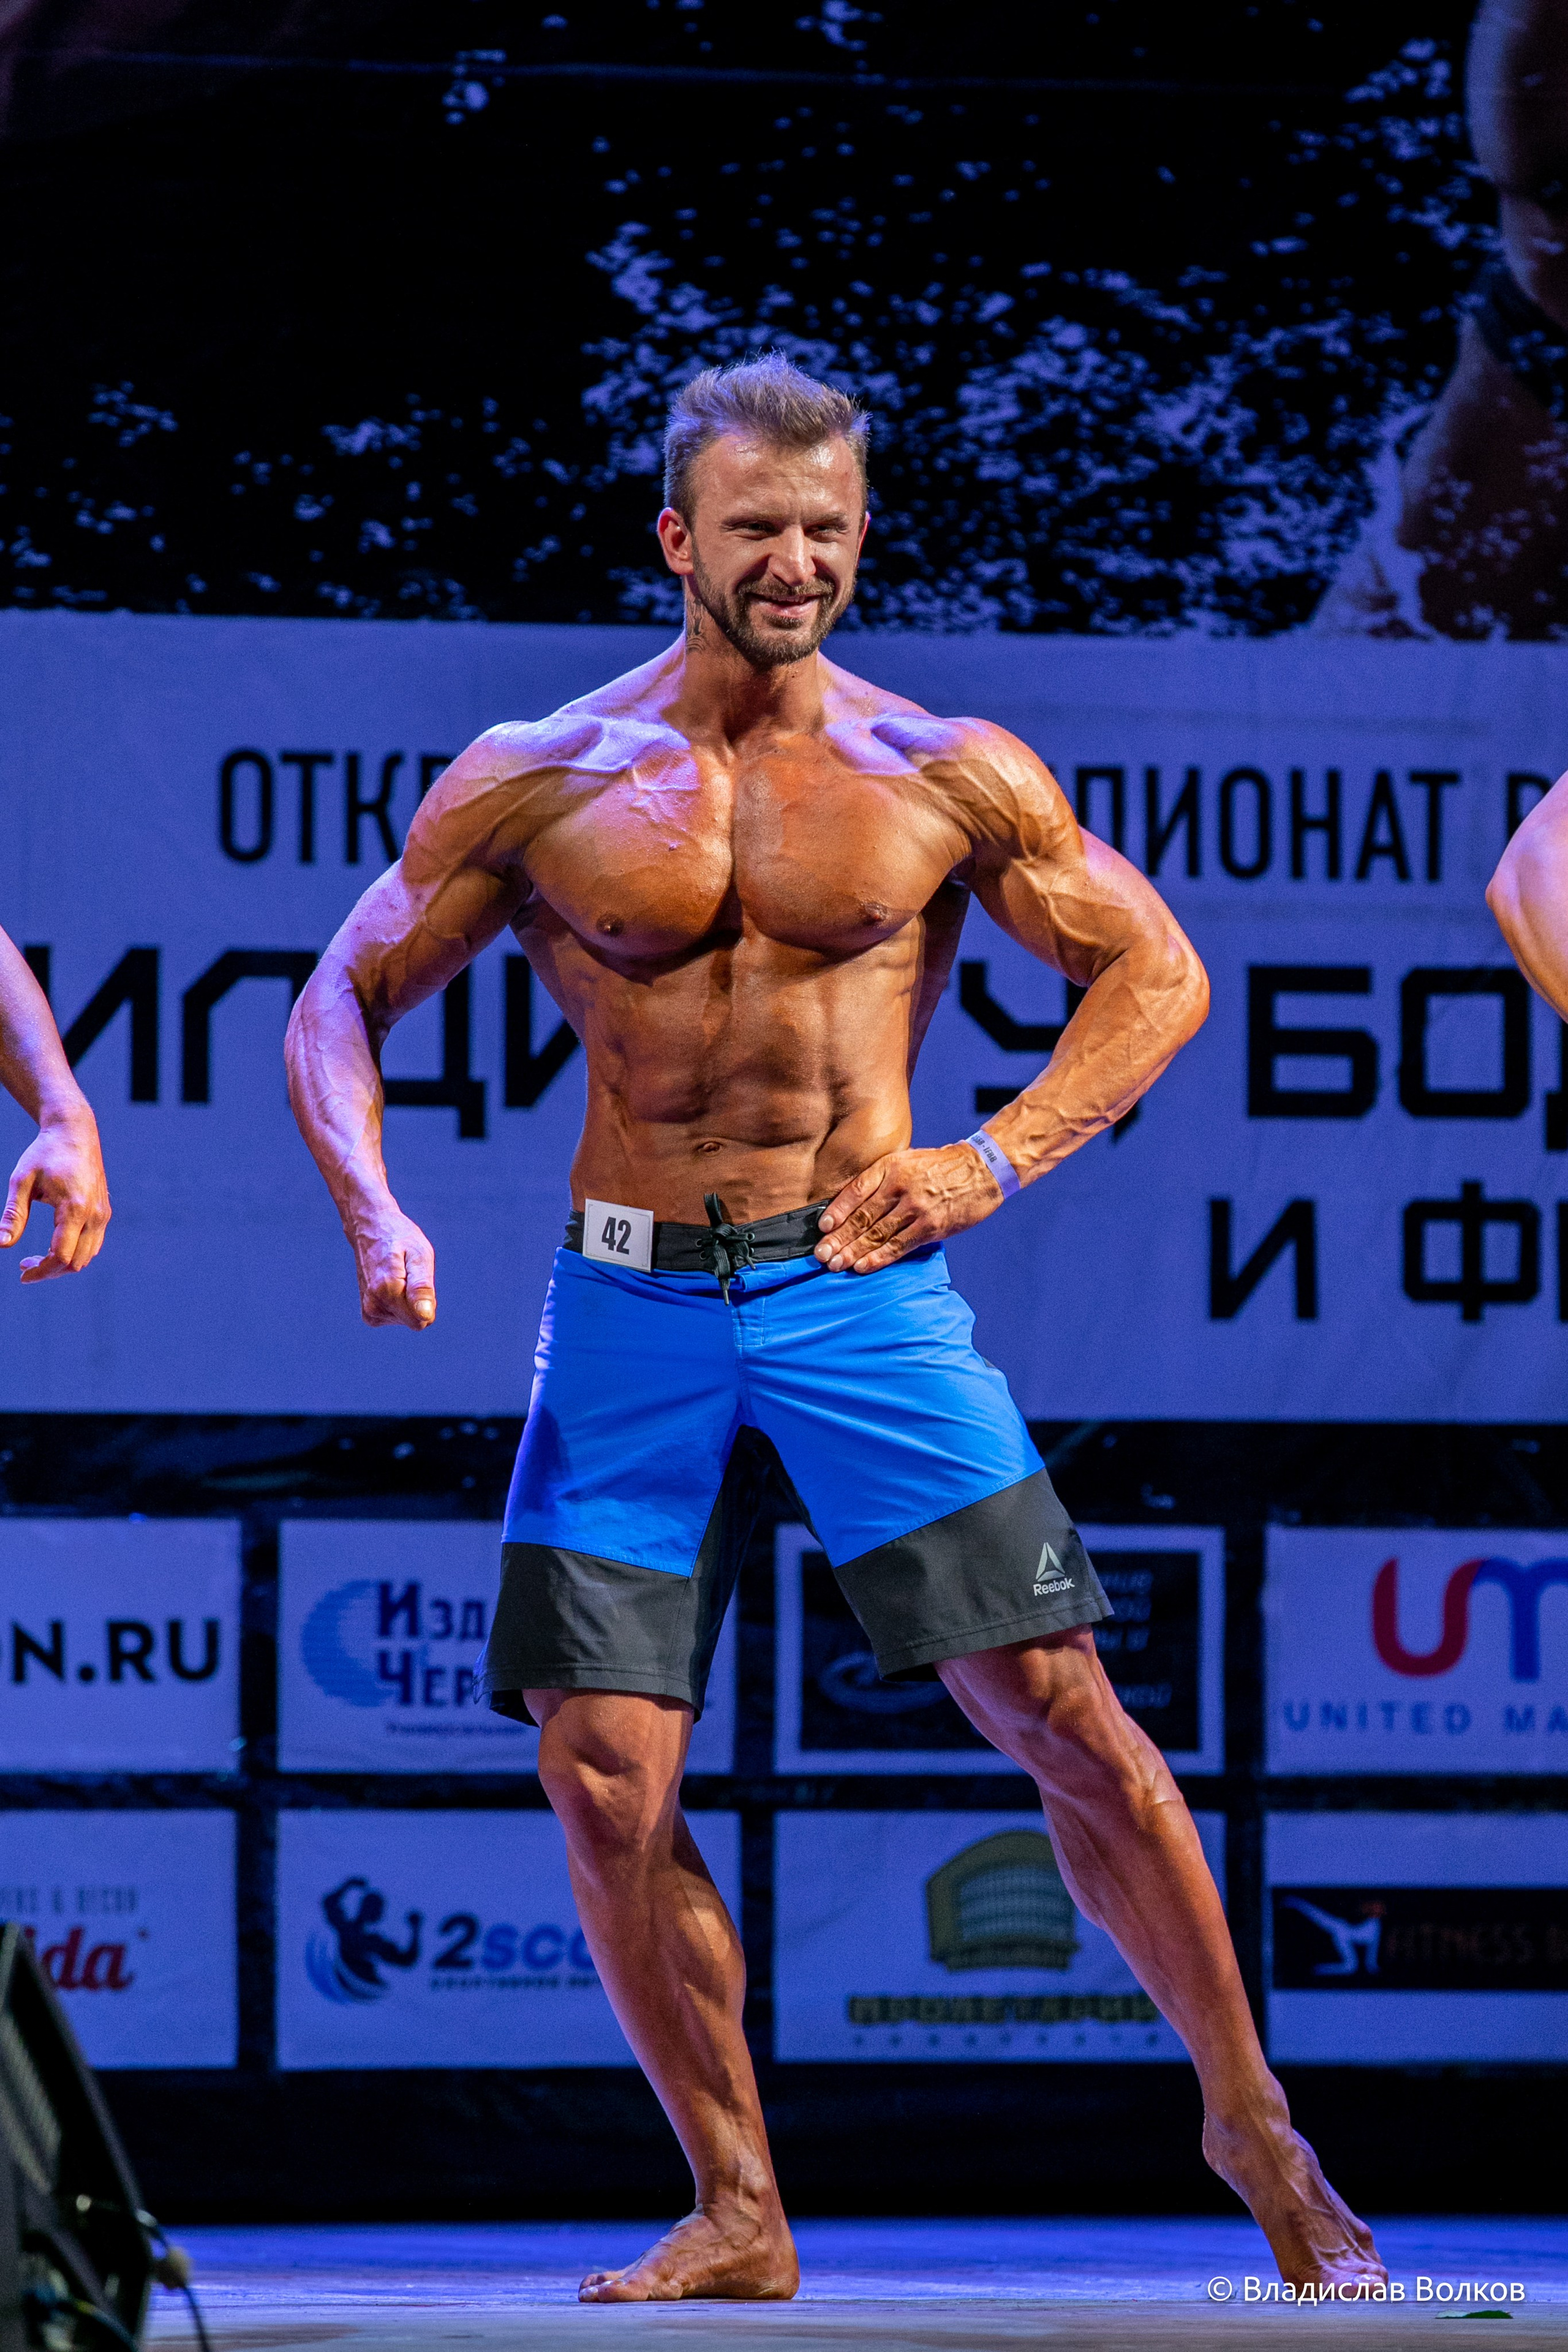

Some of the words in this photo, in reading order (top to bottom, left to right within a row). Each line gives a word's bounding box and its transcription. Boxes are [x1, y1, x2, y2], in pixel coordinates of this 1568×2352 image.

[1046, 765, 1463, 882] ПИОНАТ
[1248, 965, 1568, 1151] БО
[601, 1216, 631, 1255] 42
[1208, 1198, 1317, 1319] И
[1402, 1180, 1568, 1323] Ф
[1033, 1578, 1075, 1596] Reebok
[0, 1618, 220, 1684] N.RU
[1284, 1700, 1471, 1734] UNITED
